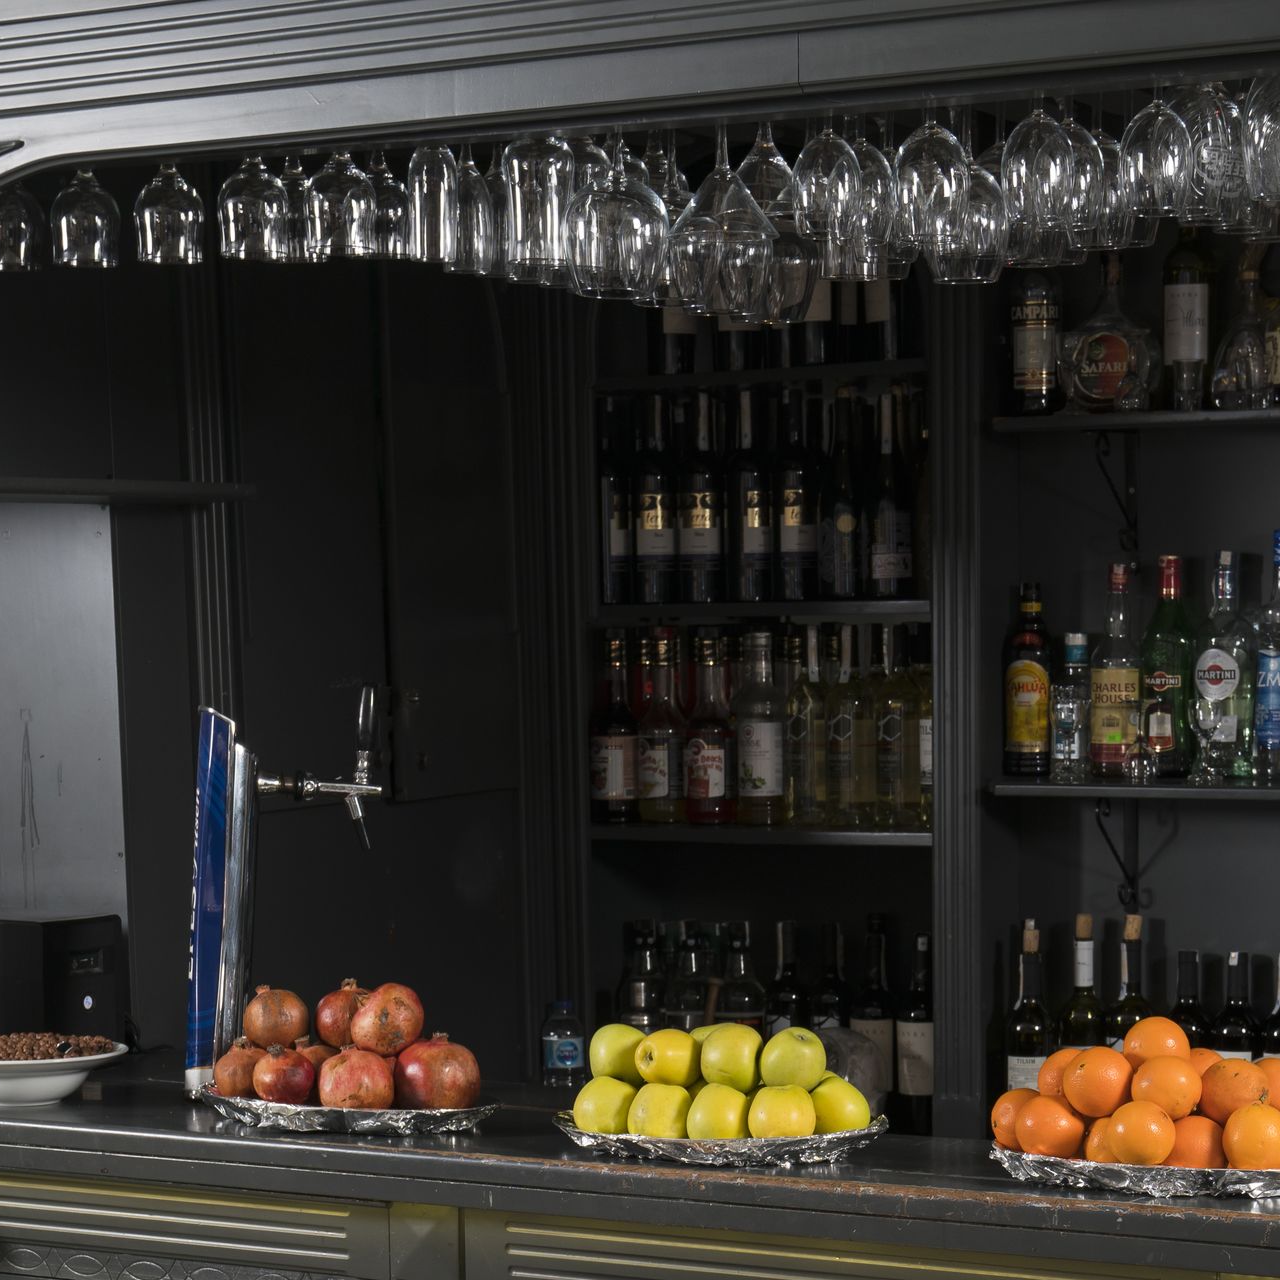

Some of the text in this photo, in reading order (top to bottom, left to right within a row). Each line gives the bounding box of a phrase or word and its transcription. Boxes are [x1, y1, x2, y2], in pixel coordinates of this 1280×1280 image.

[1010, 304, 1058, 319] CAMPARI
[1080, 360, 1129, 374] SAFARI
[1198, 669, 1235, 680] MARTINI
[1145, 676, 1179, 686] MARTINI
[1092, 682, 1136, 693] CHARLES
[1094, 693, 1132, 704] HOUSE
